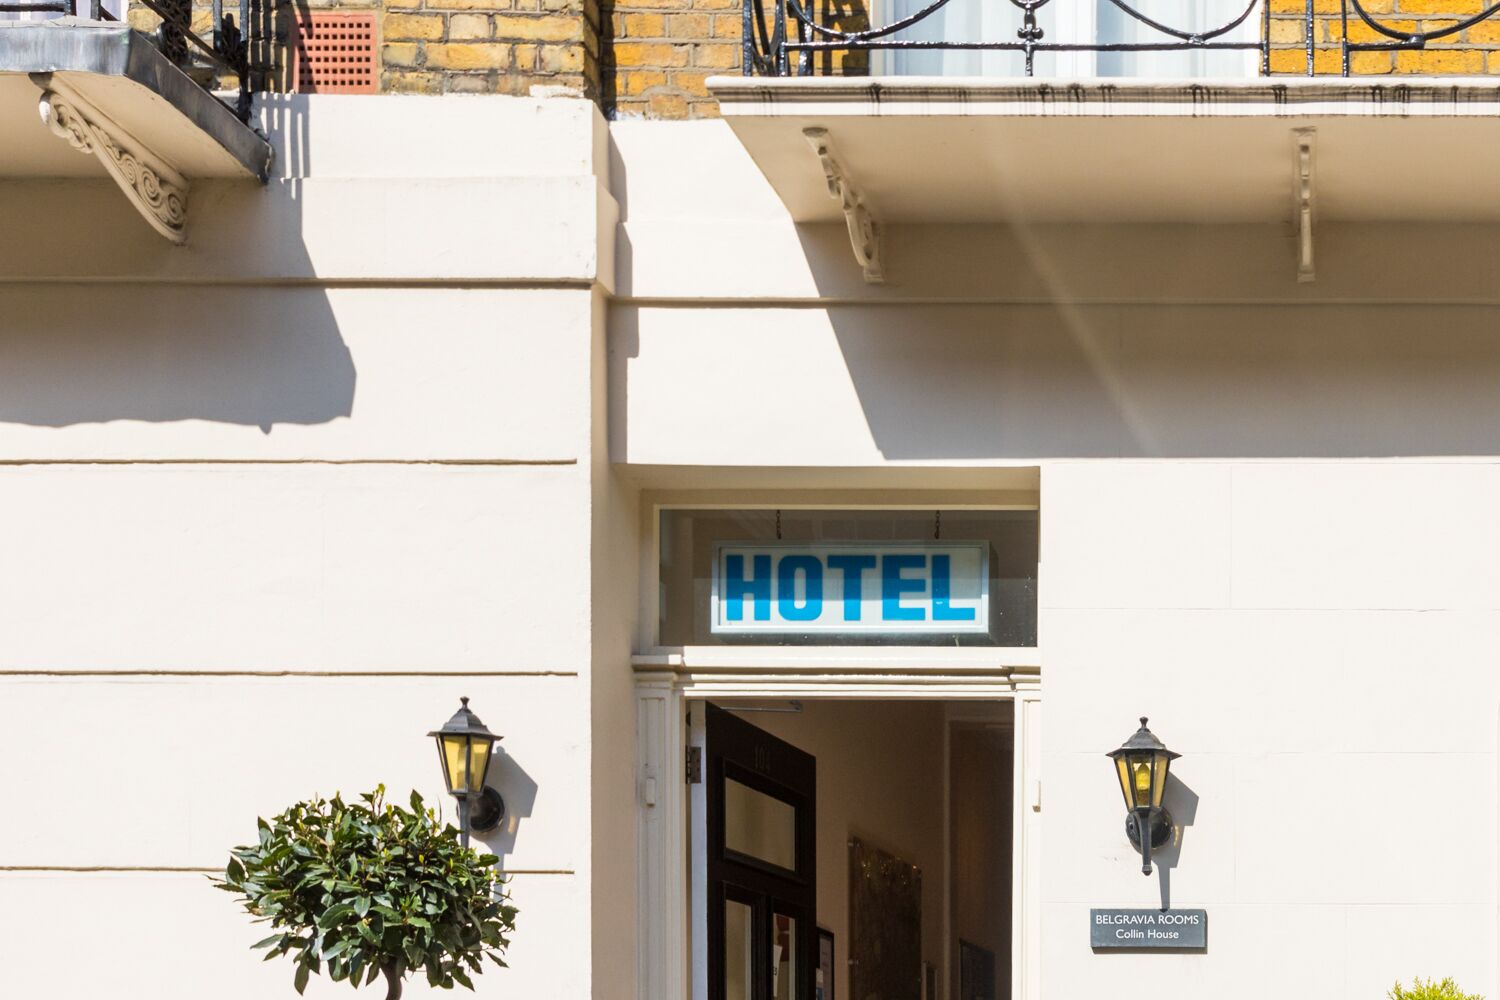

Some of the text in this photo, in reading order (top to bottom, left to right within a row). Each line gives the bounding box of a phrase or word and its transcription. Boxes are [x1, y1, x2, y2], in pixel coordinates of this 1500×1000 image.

[725, 554, 976, 621] HOTEL
[1095, 914, 1199, 925] BELGRAVIA ROOMS
[1115, 928, 1180, 939] Collin House
